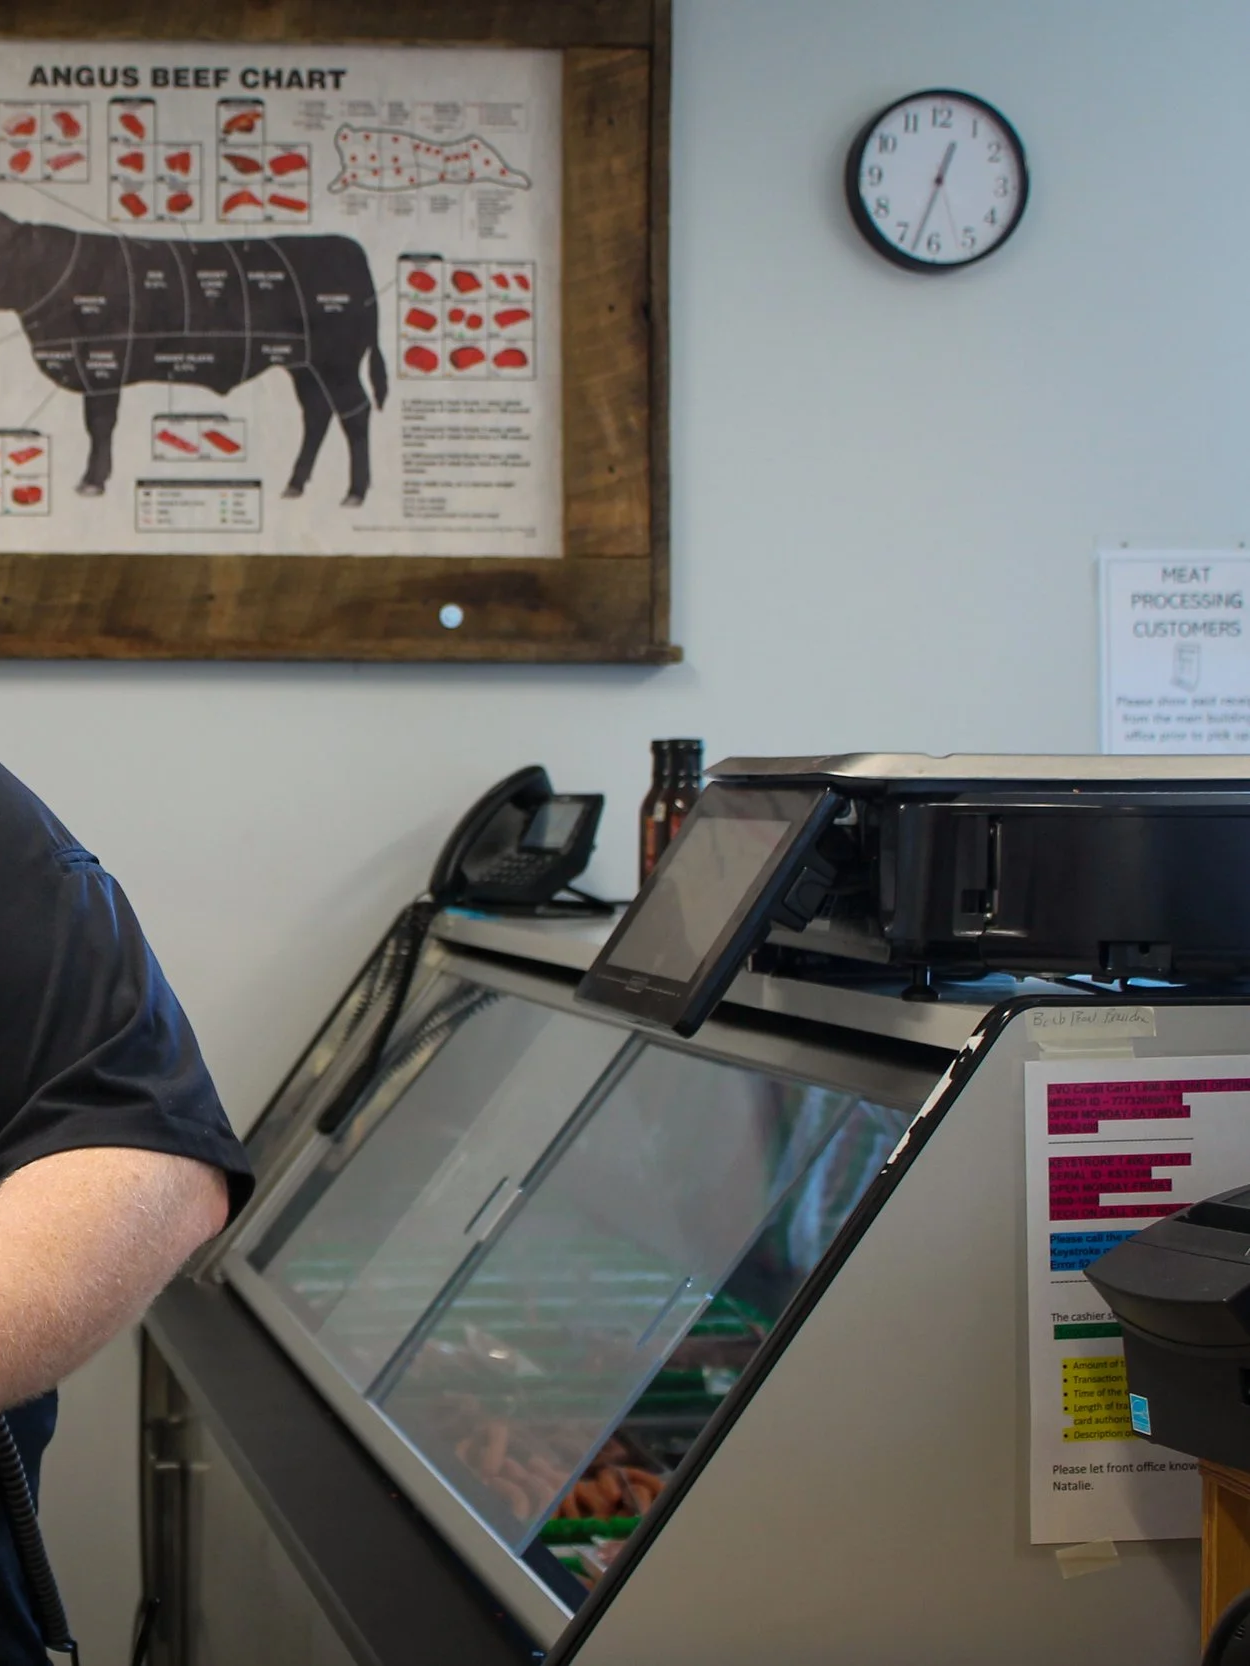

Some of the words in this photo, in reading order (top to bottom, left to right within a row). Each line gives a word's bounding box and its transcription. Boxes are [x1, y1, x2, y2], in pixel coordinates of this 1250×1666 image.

[29, 66, 140, 88] ANGUS
[152, 66, 230, 88] BEEF
[240, 68, 347, 90] CHART
[904, 113, 918, 133] 11
[932, 107, 952, 128] 12
[971, 119, 978, 138] 1
[878, 134, 896, 153] 10
[987, 142, 1001, 162] 2
[869, 165, 882, 185] 9
[994, 177, 1008, 197] 3
[875, 197, 889, 218] 8
[983, 208, 996, 225] 4
[896, 221, 909, 242] 7
[962, 227, 975, 249] 5
[927, 233, 940, 254] 6
[1161, 567, 1211, 584] MEAT
[1130, 593, 1243, 610] PROCESSING
[1133, 620, 1241, 638] CUSTOMERS
[1049, 1111, 1078, 1120] OPEN
[1050, 1234, 1082, 1244] Please
[1086, 1233, 1103, 1242] call
[1106, 1232, 1122, 1242] the
[1050, 1248, 1101, 1258] Keystroke
[1050, 1260, 1076, 1270] Error
[1050, 1313, 1069, 1322] The
[1071, 1312, 1105, 1321] cashier
[1072, 1361, 1108, 1370] Amount
[1110, 1360, 1118, 1368] of
[1073, 1375, 1124, 1384] Transaction
[1074, 1390, 1094, 1398] Time
[1096, 1388, 1106, 1396] of
[1108, 1388, 1122, 1396] the
[1073, 1402, 1102, 1413] Length
[1104, 1402, 1114, 1410] of
[1073, 1416, 1092, 1425] card
[1074, 1430, 1124, 1440] Description
[1052, 1464, 1086, 1475] Please
[1090, 1464, 1103, 1474] let
[1106, 1462, 1134, 1474] front
[1136, 1462, 1166, 1472] office
[1168, 1461, 1197, 1471] know
[1053, 1480, 1094, 1492] Natalie.
